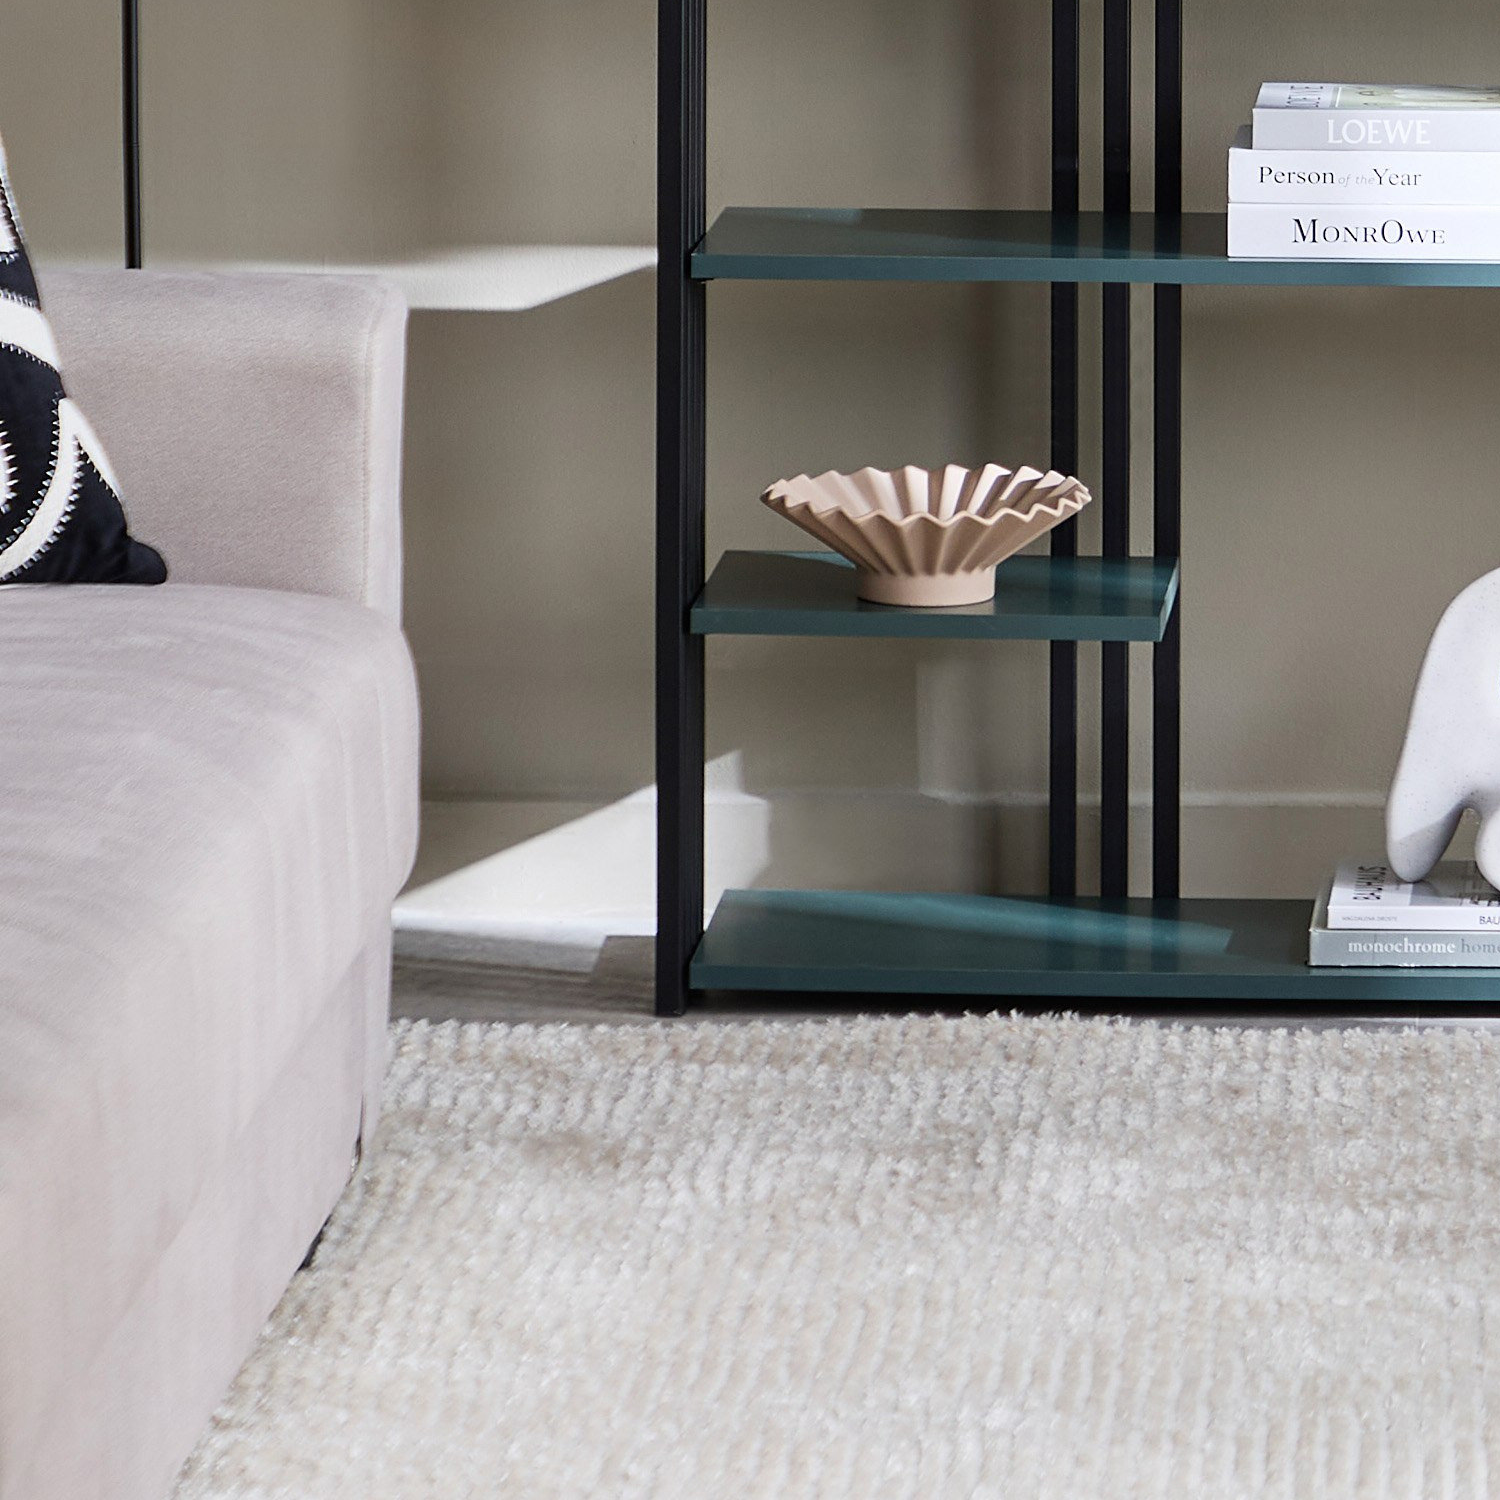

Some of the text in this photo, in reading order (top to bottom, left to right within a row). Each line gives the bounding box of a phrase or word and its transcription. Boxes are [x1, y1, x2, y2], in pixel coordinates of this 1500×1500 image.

[1327, 118, 1432, 146] LOEWE
[1259, 166, 1422, 187] Person of the Year
[1347, 937, 1457, 955] monochrome
